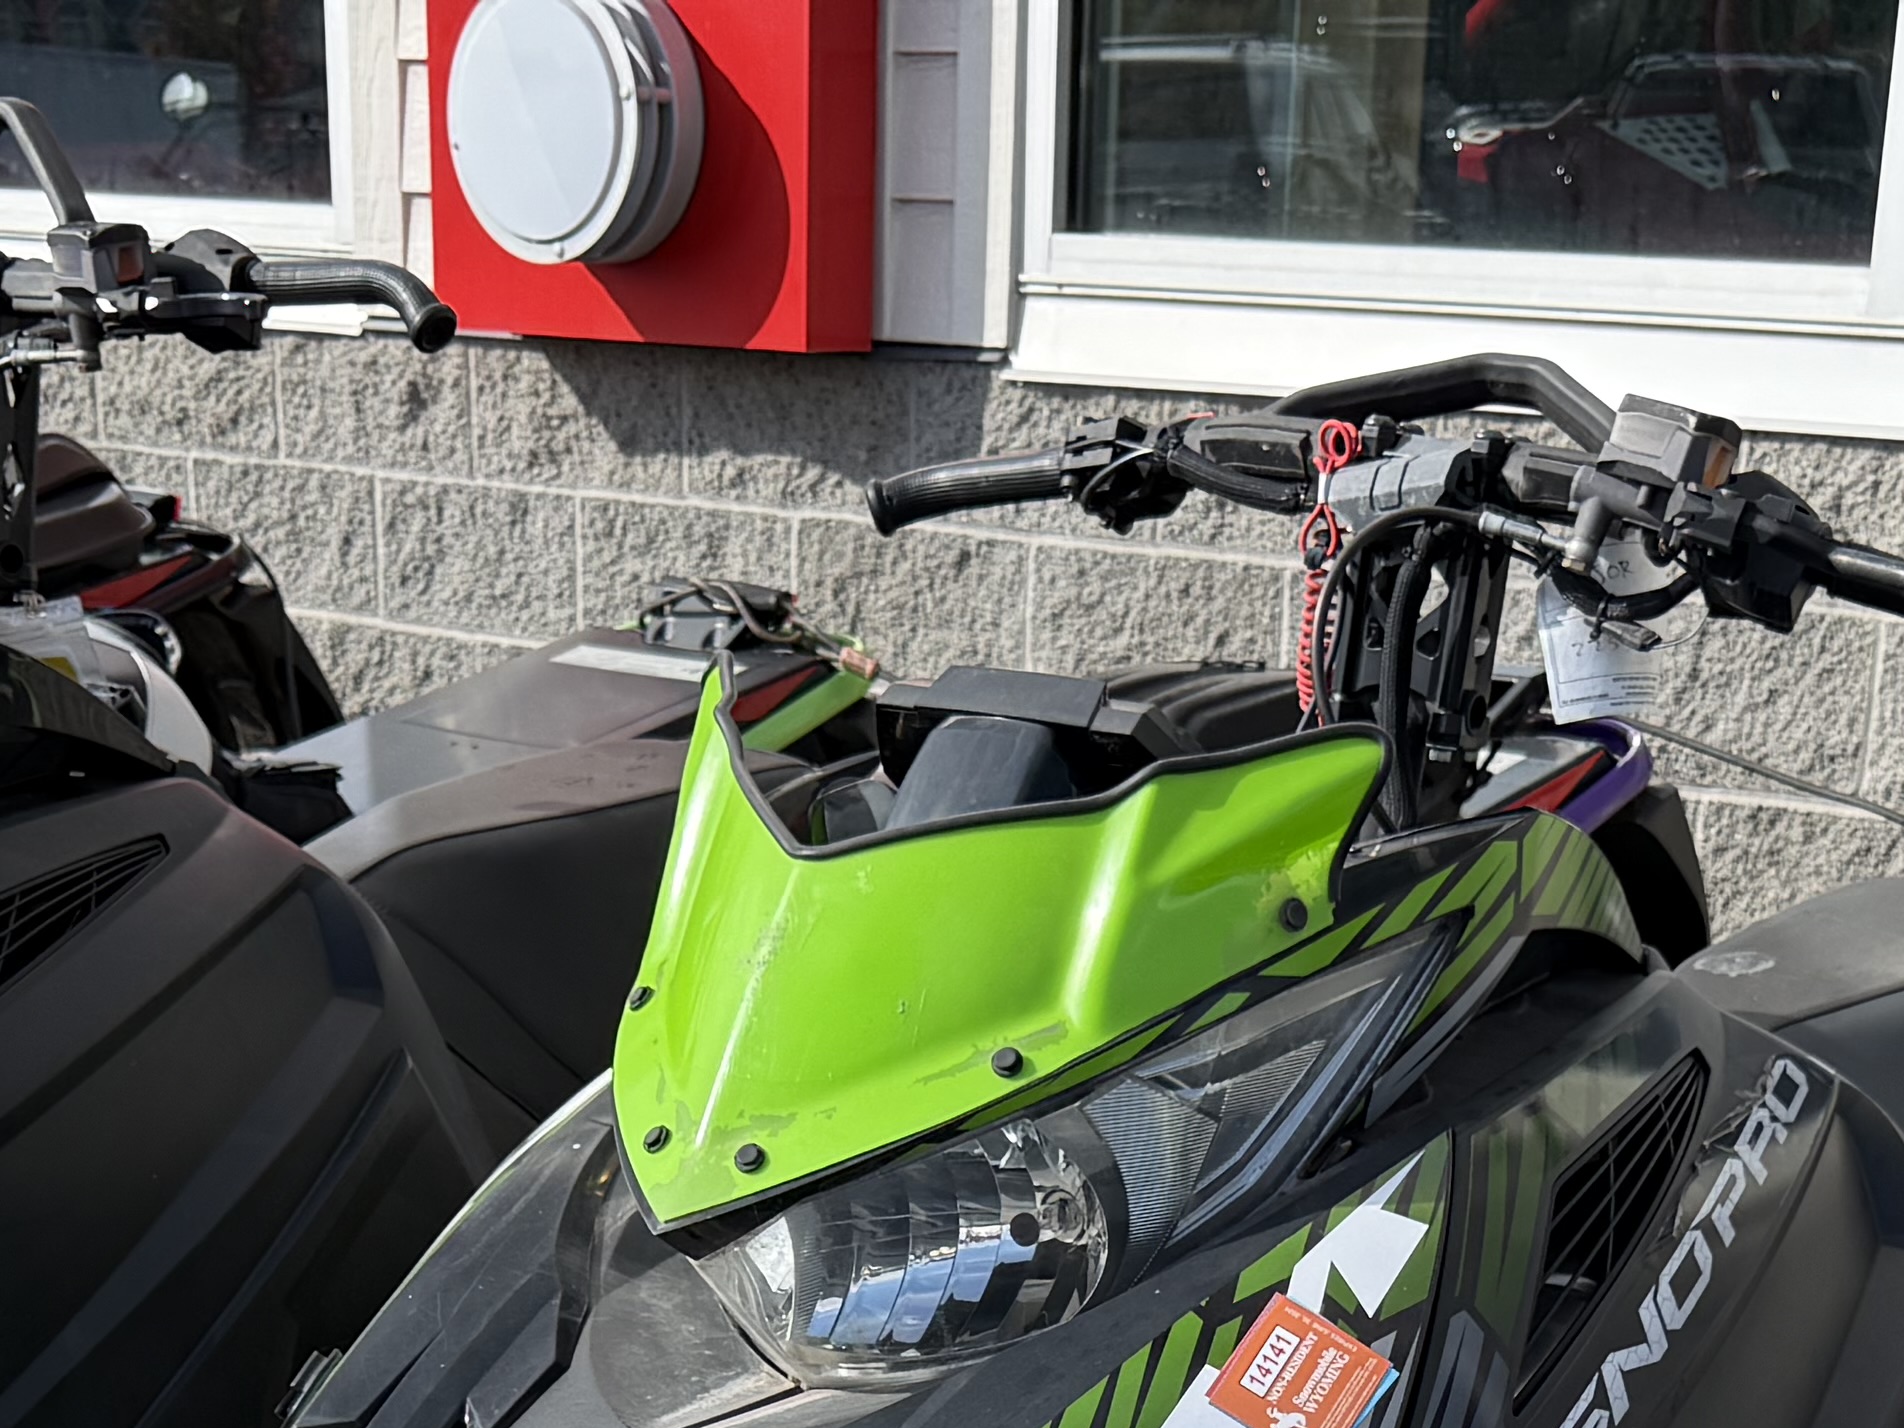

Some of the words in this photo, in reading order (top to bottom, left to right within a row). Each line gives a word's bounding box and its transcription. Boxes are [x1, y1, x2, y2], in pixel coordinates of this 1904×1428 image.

[1249, 1334, 1292, 1387] 14141
[1264, 1331, 1319, 1404] NON-RESIDENT
[1292, 1347, 1339, 1408] Snowmobile
[1303, 1353, 1350, 1414] WYOMING
